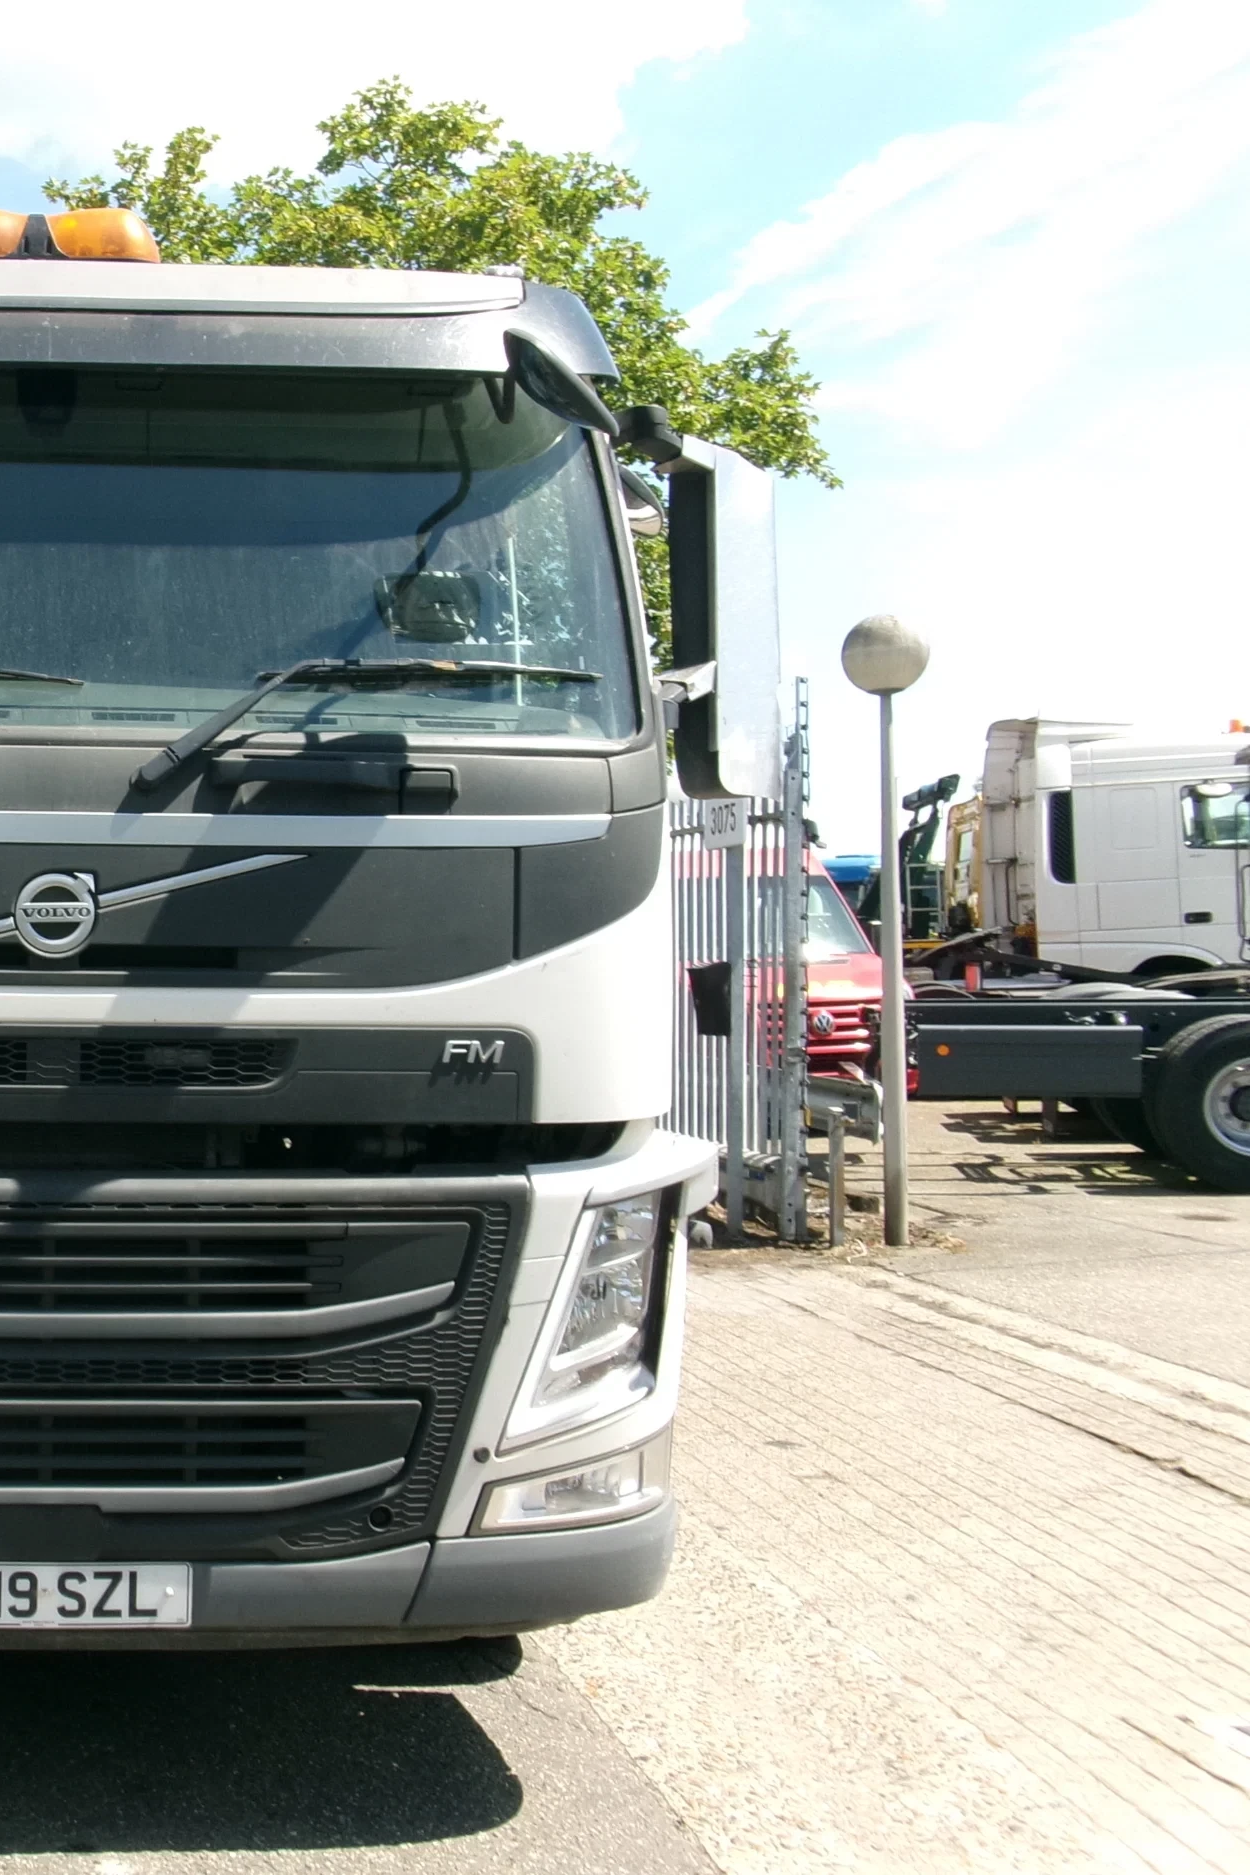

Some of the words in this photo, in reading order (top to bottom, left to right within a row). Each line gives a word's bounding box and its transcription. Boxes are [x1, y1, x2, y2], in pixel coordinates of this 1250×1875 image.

[711, 802, 736, 835] 3075
[19, 907, 91, 918] VOLVO
[442, 1040, 505, 1063] FM
[57, 1570, 158, 1618] SZL
